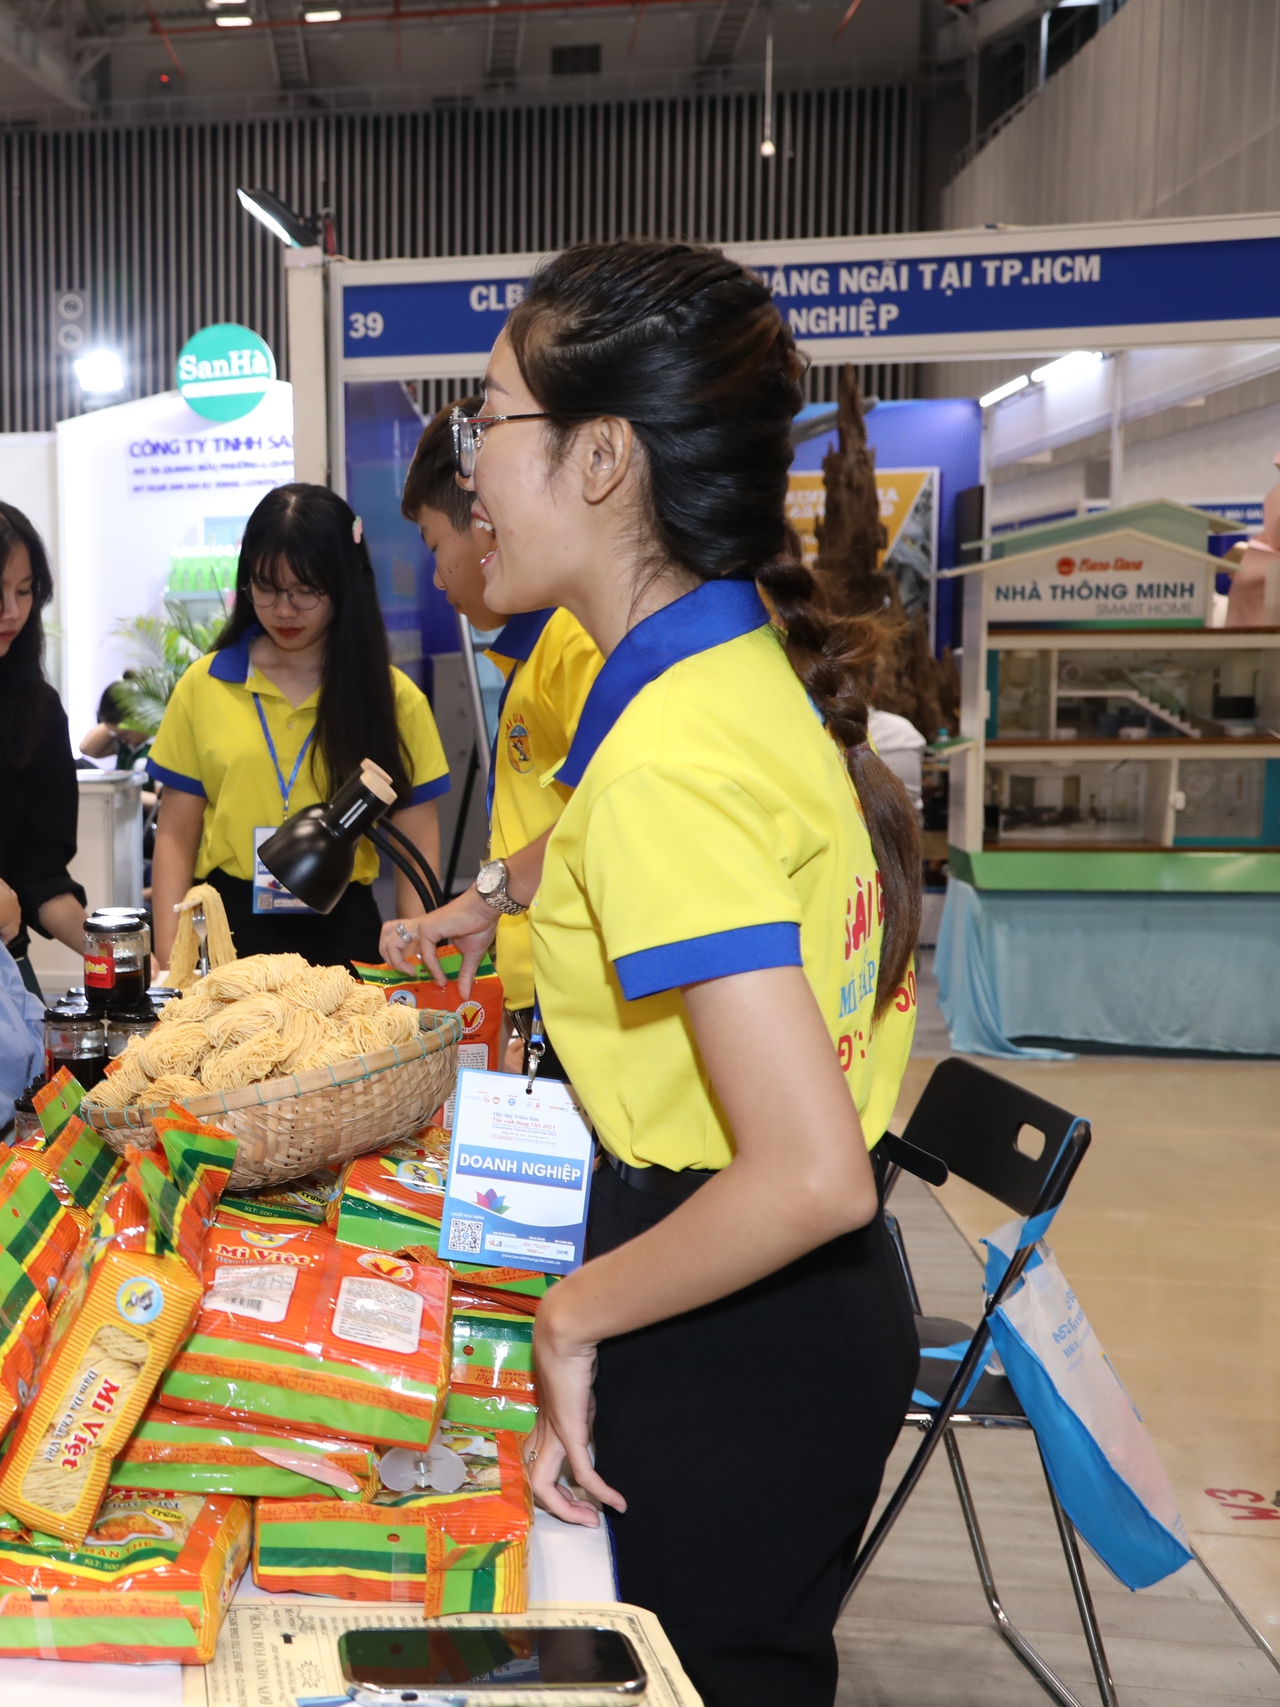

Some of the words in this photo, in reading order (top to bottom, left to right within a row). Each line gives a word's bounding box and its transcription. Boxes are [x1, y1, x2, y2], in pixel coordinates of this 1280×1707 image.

[470, 284, 525, 312] CLB
[762, 265, 830, 298] ẢNG
[839, 259, 909, 294] NGÃI
[919, 262, 972, 296] TẠI
[982, 254, 1101, 288] TP.HCM
[349, 311, 384, 339] 39
[788, 298, 900, 337] NGHIỆP
[129, 438, 180, 458] CÔNG
[184, 438, 208, 456] TY
[214, 436, 262, 453] TNHH
[268, 435, 294, 450] SA
[995, 580, 1041, 601] NHÀ
[1049, 580, 1128, 601] THÔNG
[1136, 582, 1195, 598] MINH
[1096, 603, 1143, 616] SMART
[1148, 602, 1193, 615] HOME
[459, 1153, 517, 1174] DOANH
[521, 1163, 581, 1183] NGHIỆP
[90, 1378, 121, 1415] Mì
[60, 1418, 106, 1471] Việt
[254, 1641, 267, 1657] FOR
